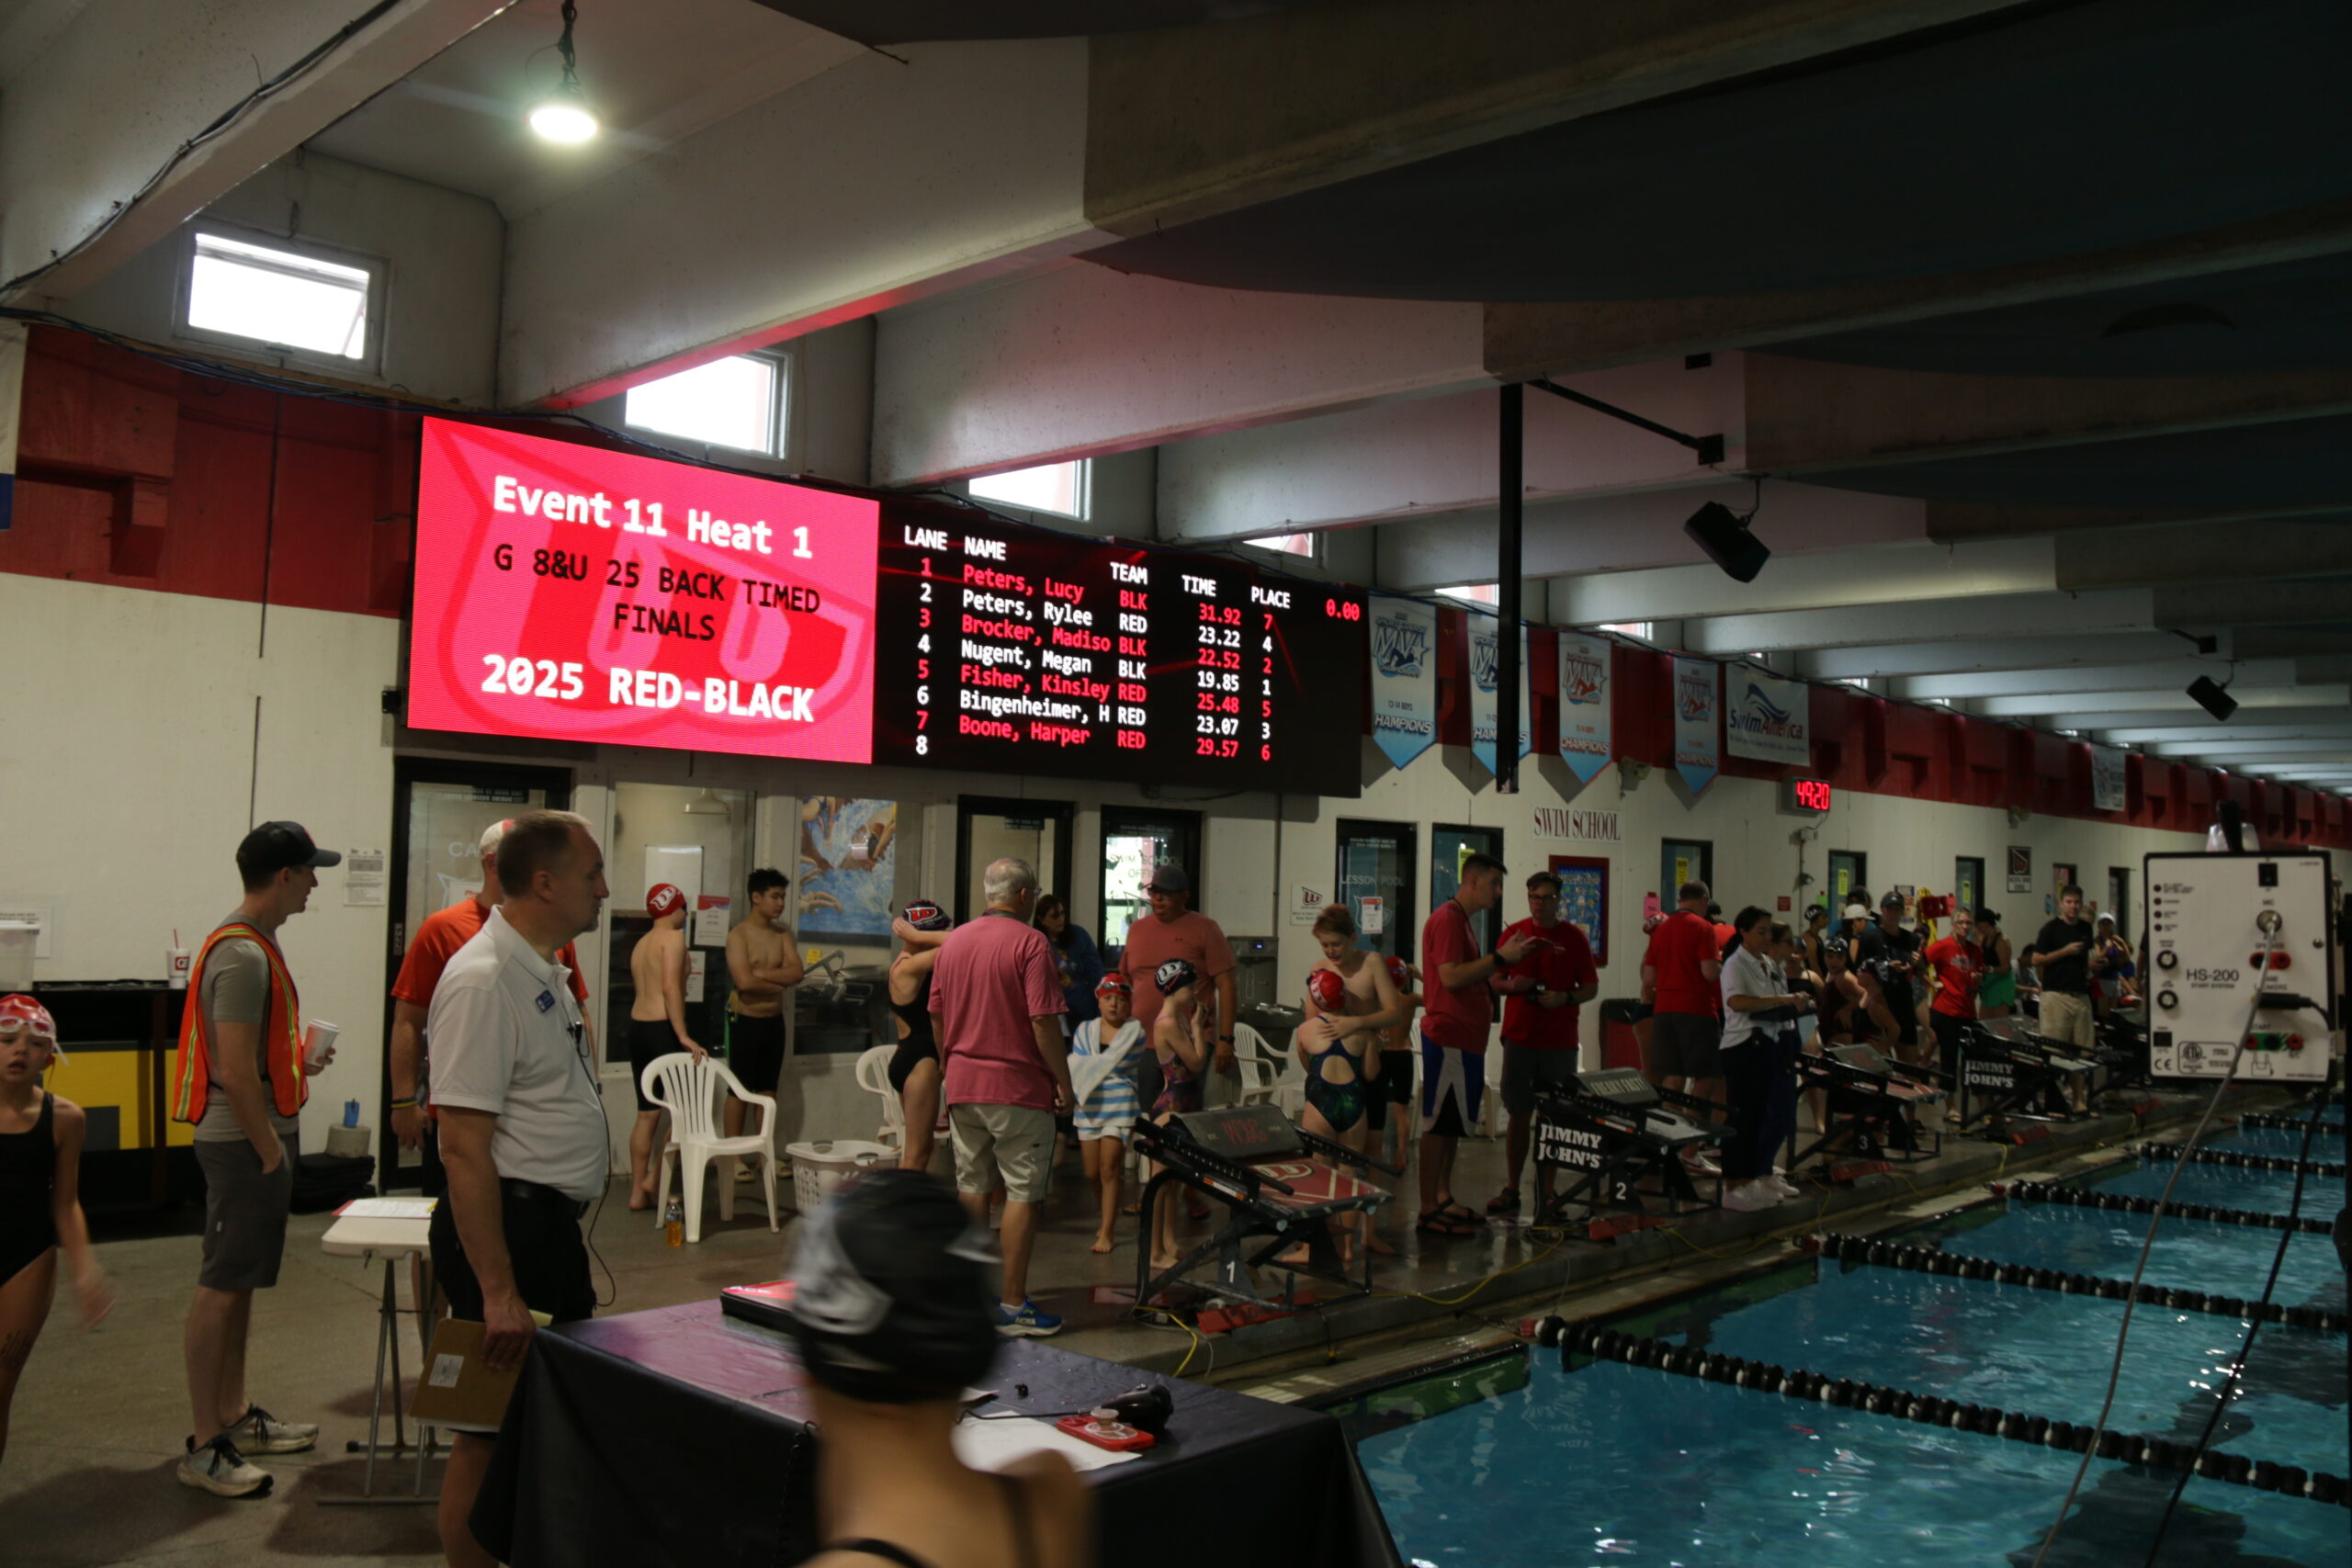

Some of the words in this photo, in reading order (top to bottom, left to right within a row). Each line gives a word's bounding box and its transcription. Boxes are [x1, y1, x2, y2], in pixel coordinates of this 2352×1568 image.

[493, 475, 611, 528] Event
[623, 500, 667, 536] 11
[687, 509, 772, 554] Heat
[793, 526, 812, 558] 1
[494, 544, 513, 571] G
[534, 549, 588, 581] 8&U
[606, 559, 639, 589] 25
[659, 568, 725, 601] BACK
[742, 580, 820, 615] TIMED
[904, 525, 947, 551] LANE
[965, 536, 1006, 561] NAME
[1110, 561, 1148, 586] TEAM
[1182, 574, 1216, 597] TIME
[1250, 586, 1291, 609] PLACE
[921, 558, 932, 578] 1
[964, 563, 1033, 597] Peters,
[1045, 577, 1084, 604] Lucy
[1119, 590, 1148, 611] BLK
[1199, 603, 1241, 625] 31.92
[1263, 614, 1272, 631] 7
[1326, 599, 1360, 622] 0.00
[614, 603, 715, 641] FINALS
[920, 582, 932, 603] 2
[963, 589, 1033, 621] Peters,
[1044, 601, 1092, 626] Rylee
[1119, 614, 1148, 634] RED
[1198, 626, 1240, 648] 23.22
[1262, 637, 1272, 652] 4
[920, 608, 931, 628] 3
[962, 614, 1042, 646] Brocker,
[1052, 627, 1111, 653] Madiso
[1119, 637, 1147, 657] BLK
[1198, 648, 1240, 670] 22.52
[1262, 658, 1272, 674] 2
[918, 634, 931, 653] 4
[961, 639, 1032, 671] Nugent,
[1042, 650, 1091, 675] Megan
[1118, 660, 1146, 680] BLK
[1197, 671, 1239, 692] 19.85
[1262, 680, 1271, 696] 1
[481, 654, 583, 700] 2025
[608, 667, 814, 722] RED-BLACK
[917, 660, 930, 679] 5
[960, 664, 1032, 695] Fisher,
[1042, 675, 1111, 705] Kinsley
[1118, 682, 1147, 703] RED
[1197, 692, 1239, 714] 25.48
[1262, 701, 1271, 717] 5
[917, 685, 930, 705] 6
[960, 689, 1089, 724] Bingenheimer,
[1098, 704, 1110, 723] H
[1118, 706, 1146, 727] RED
[1196, 715, 1238, 736] 23.07
[1261, 722, 1271, 739] 3
[916, 711, 929, 730] 7
[959, 715, 1020, 742] Boone,
[1030, 722, 1091, 748] Harper
[1117, 729, 1146, 750] RED
[1196, 737, 1238, 759] 29.57
[1261, 744, 1271, 761] 6
[916, 735, 928, 755] 8
[1534, 807, 1569, 838] SWIM
[1573, 810, 1621, 840] SCHOOL
[1340, 874, 1376, 886] LESSON
[1381, 876, 1405, 886] POOL
[2187, 969, 2239, 982] HS-200
[1963, 1072, 2014, 1089] JOHN'S
[1965, 1059, 2014, 1075] JIMMY
[1539, 1122, 1602, 1149] JIMMY
[1860, 1134, 1869, 1150] 3
[1537, 1142, 1602, 1169] JOHN'S
[1615, 1181, 1627, 1201] 2
[1227, 1261, 1236, 1283] 1
